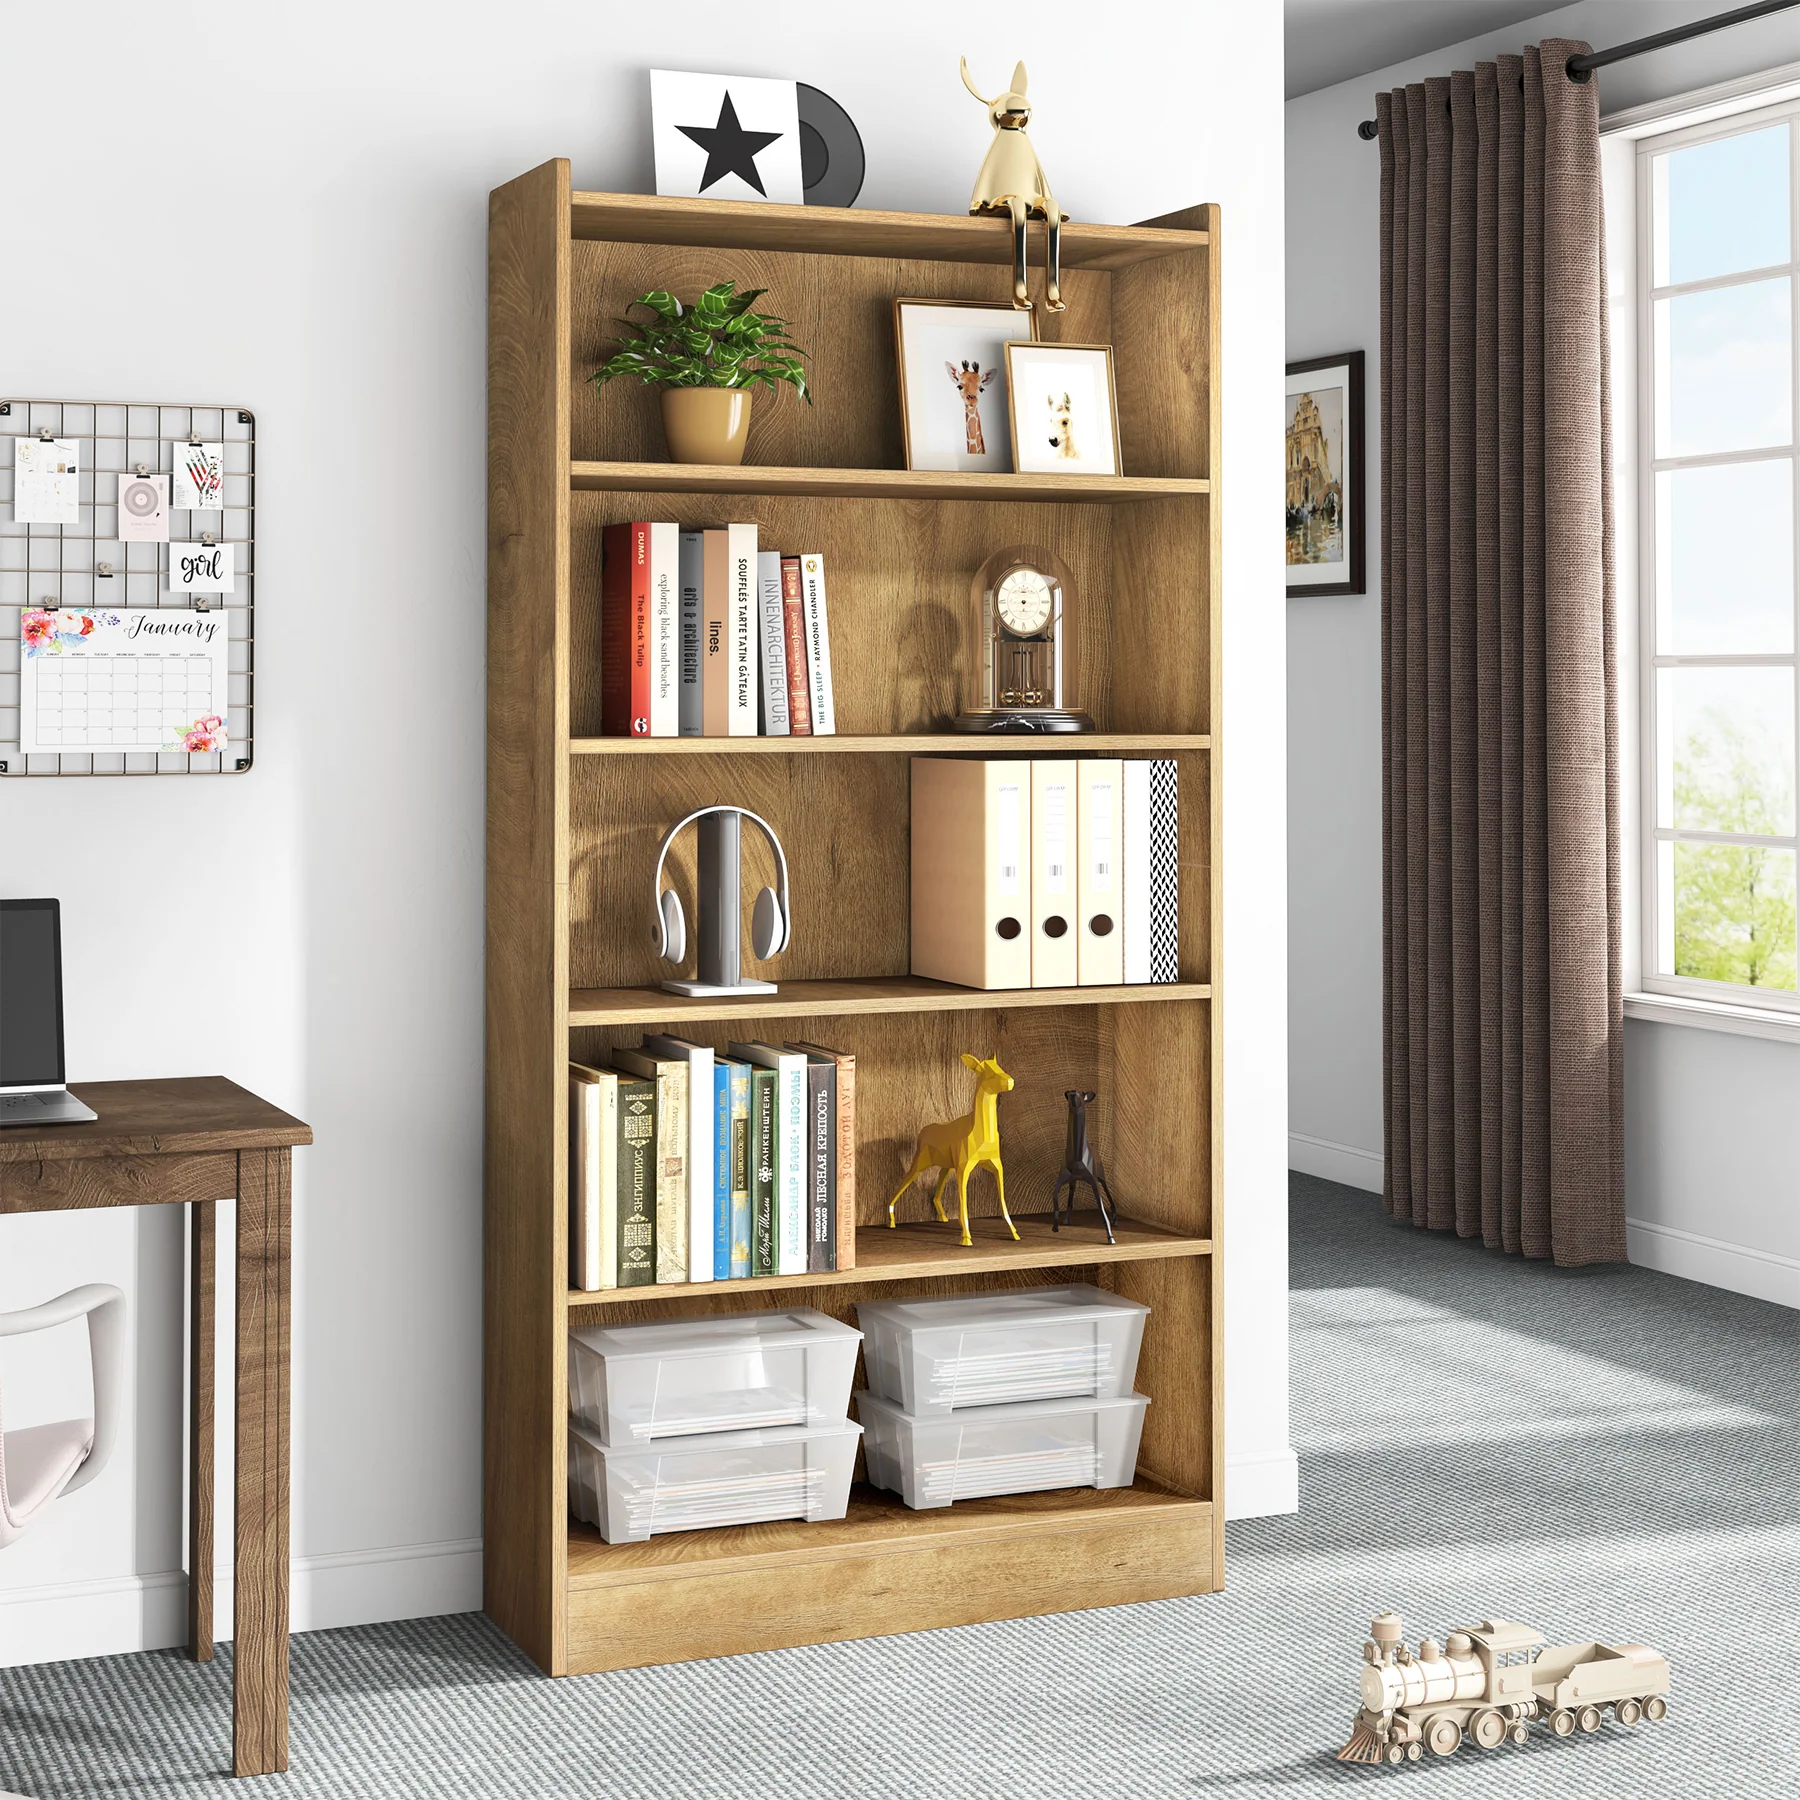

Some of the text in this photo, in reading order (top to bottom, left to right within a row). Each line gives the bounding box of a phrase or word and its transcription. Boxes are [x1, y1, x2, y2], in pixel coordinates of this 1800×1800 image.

[181, 550, 224, 583] girl
[683, 587, 699, 607] arts
[809, 579, 819, 619] CHANDLER
[123, 615, 221, 643] January
[637, 615, 645, 641] Black
[658, 573, 670, 699] exploring black sand beaches
[709, 621, 722, 656] lines.
[738, 559, 750, 708] SOUFFLÉS TARTE TATIN GÂTEAUX
[812, 621, 821, 661] RAYMOND
[636, 644, 645, 667] Tulip
[683, 623, 700, 684] architecture
[764, 579, 787, 724] INNENARCHITEKTUR
[815, 671, 824, 692] SLEEP
[817, 695, 825, 708] BIG
[789, 1070, 801, 1256] АЛЕКСАНДР БЛОК ПОЭМЫ
[816, 1089, 828, 1203] ЛЕСНАЯ КРЕПОСТЬ
[758, 1197, 771, 1237] Шелли
[814, 1206, 822, 1243] НИКОЛАЙ
[758, 1232, 773, 1267] Мэри
